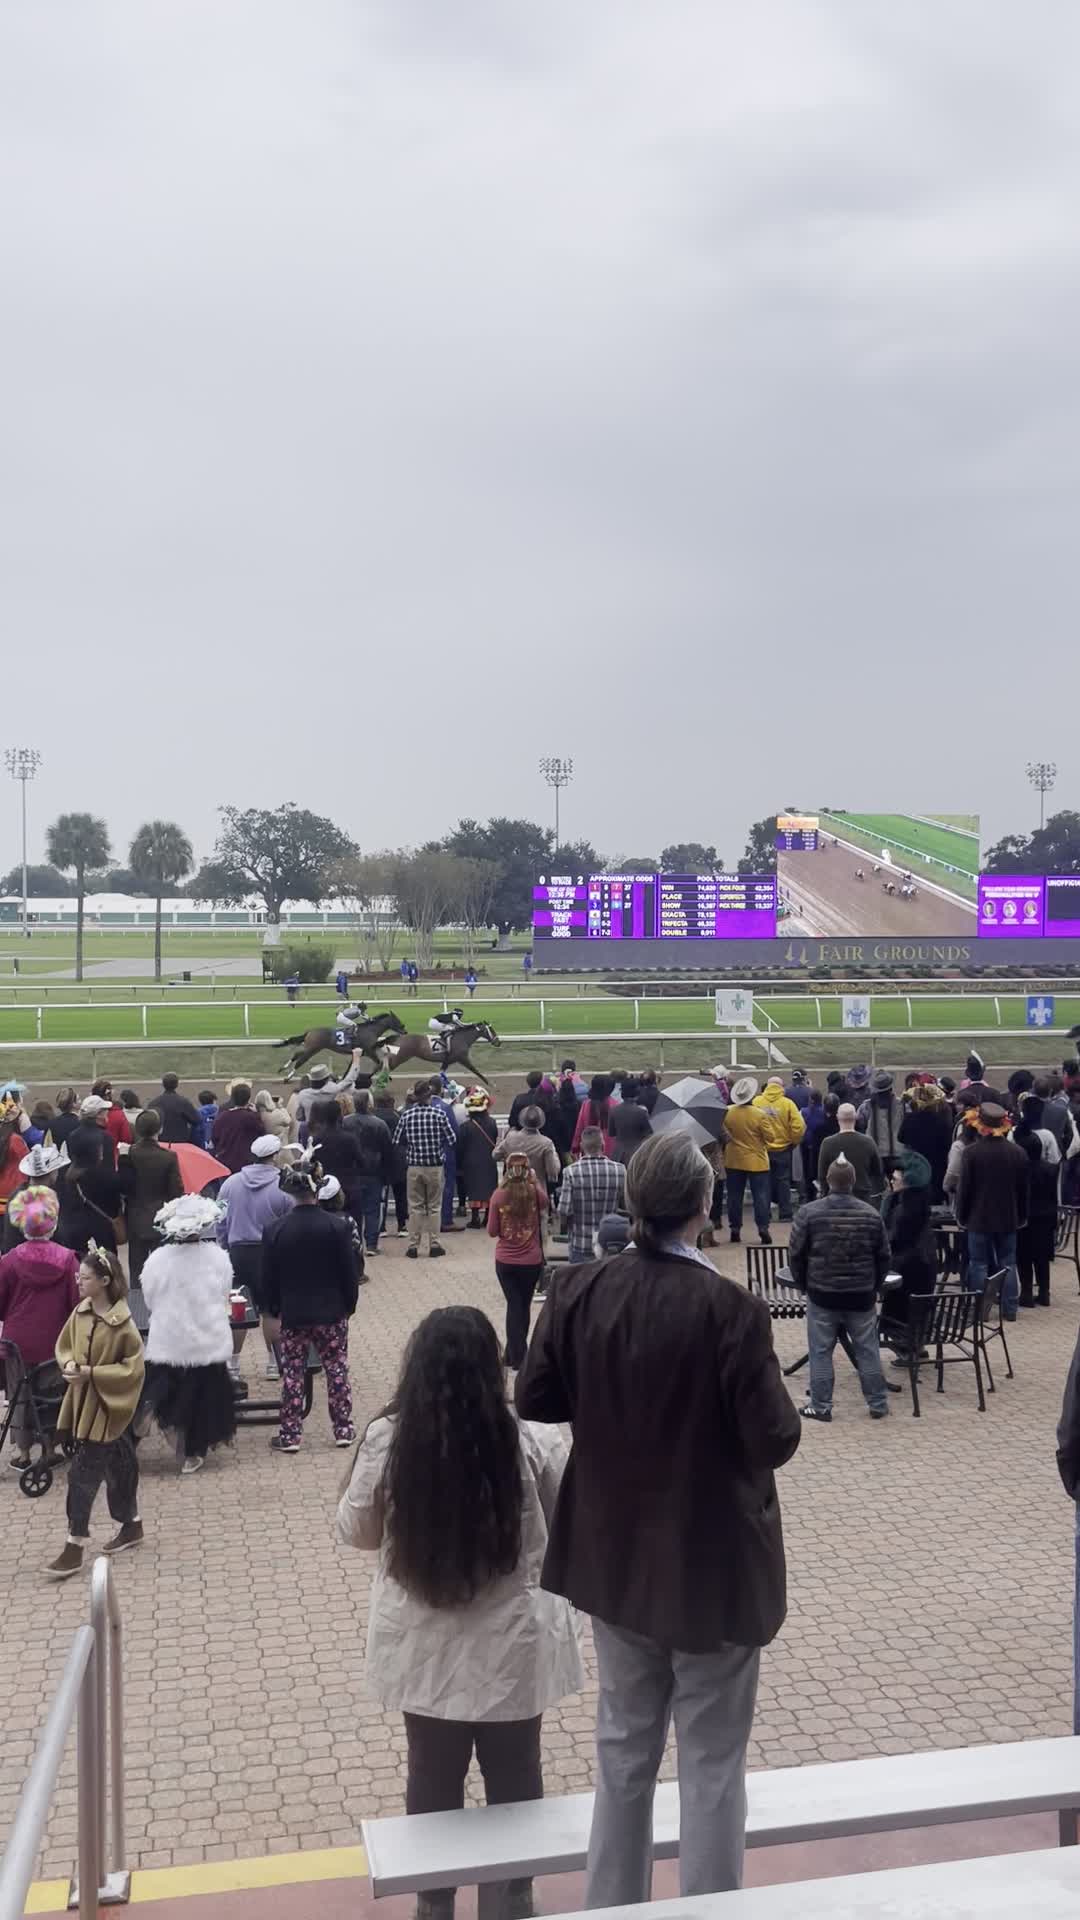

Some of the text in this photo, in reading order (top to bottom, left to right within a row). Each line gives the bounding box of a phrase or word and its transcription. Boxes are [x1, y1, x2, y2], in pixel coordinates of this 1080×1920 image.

[539, 875, 546, 885] 0
[577, 875, 584, 885] 2
[819, 944, 971, 961] FAIR GROUNDS
[336, 1031, 345, 1045] 3
